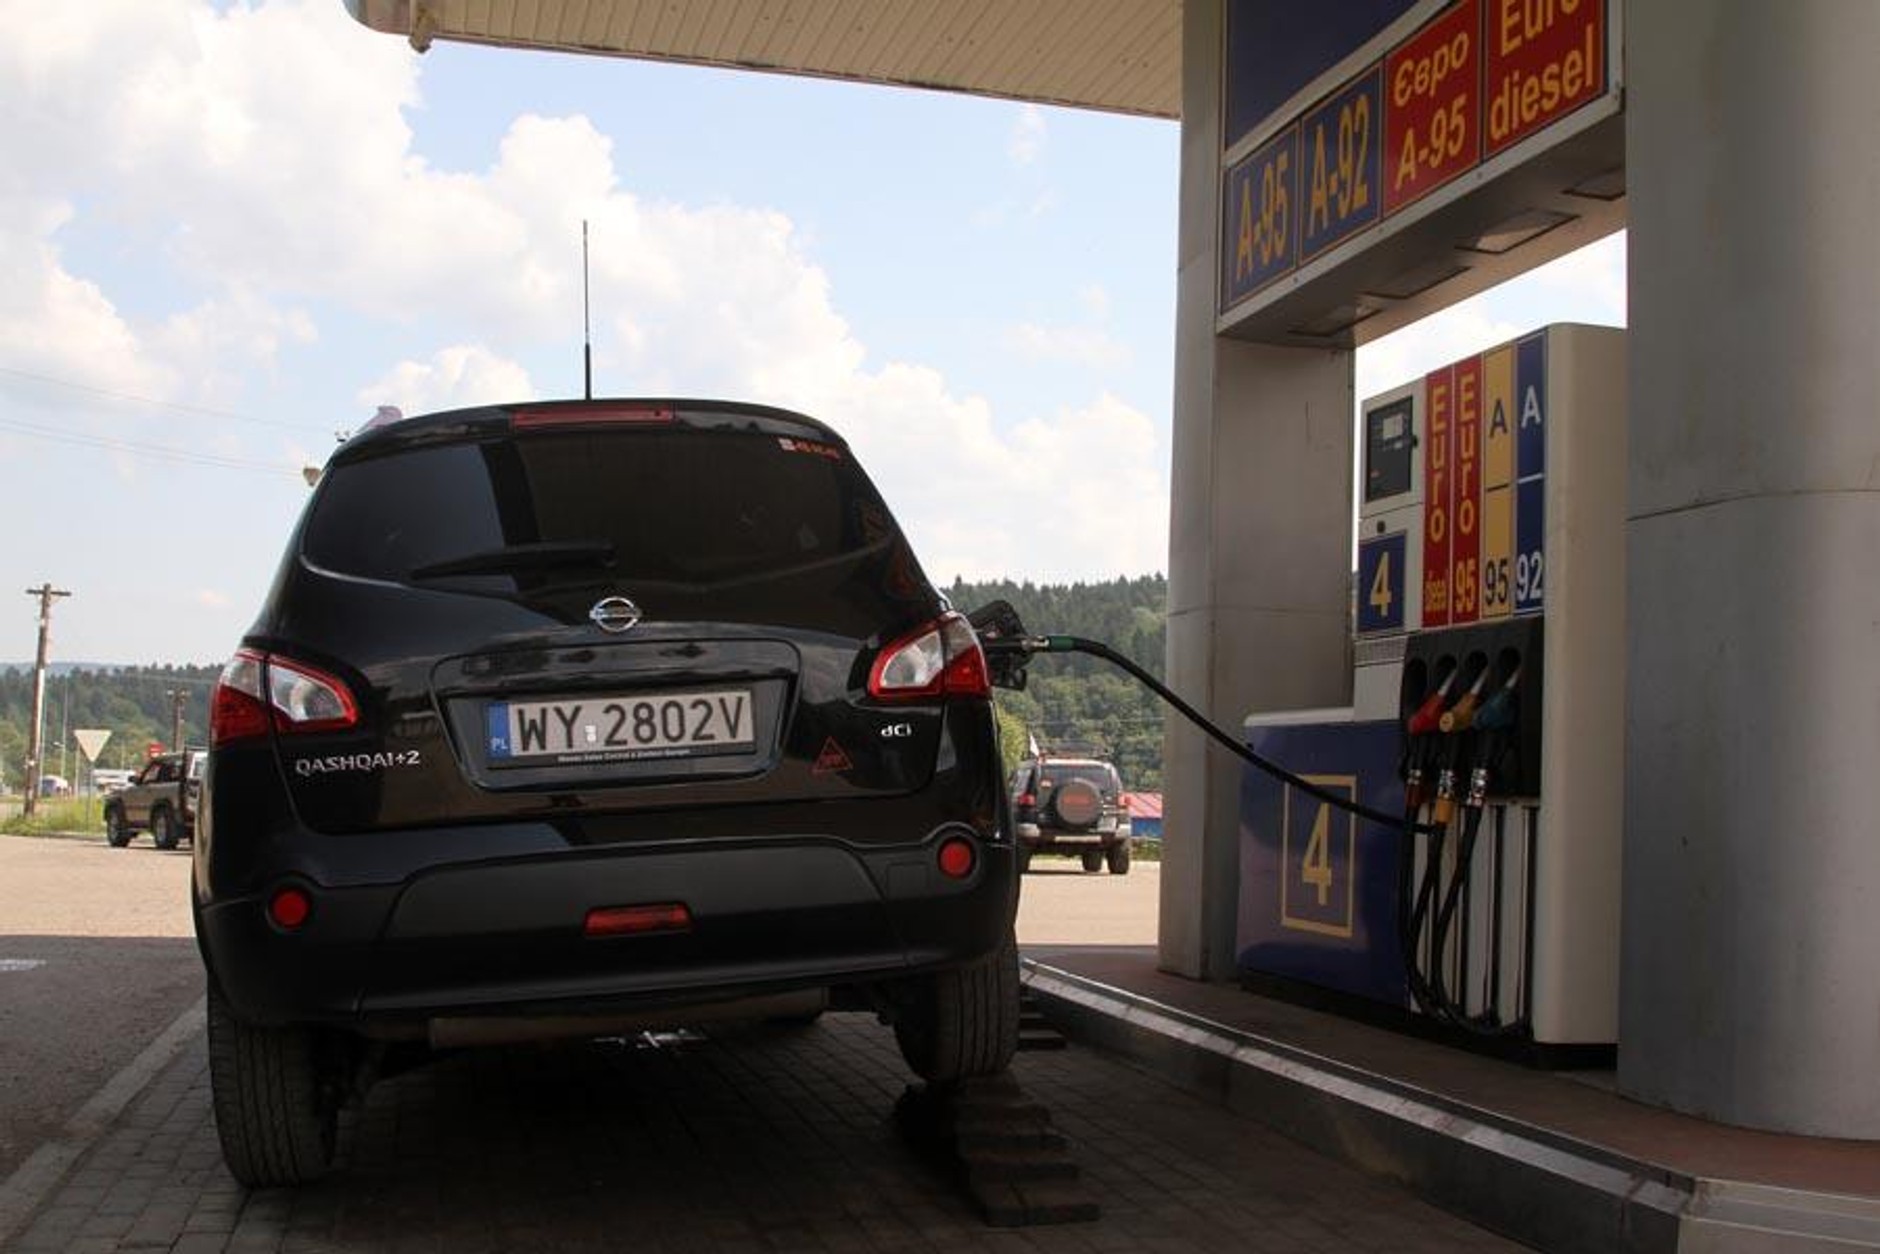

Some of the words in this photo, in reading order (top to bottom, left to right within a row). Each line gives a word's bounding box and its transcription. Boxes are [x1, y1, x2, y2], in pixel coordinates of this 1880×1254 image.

[1490, 23, 1593, 140] diesel
[1430, 384, 1448, 543] Euro
[1459, 372, 1476, 536] Euro
[1370, 551, 1392, 617] 4
[1455, 558, 1476, 613] 95
[1485, 560, 1508, 606] 95
[1516, 550, 1543, 609] 92
[491, 738, 508, 751] PL
[518, 705, 582, 752] WY
[602, 696, 744, 747] 2802V
[296, 750, 420, 776] QASHQAI+2
[1302, 802, 1332, 906] 4
